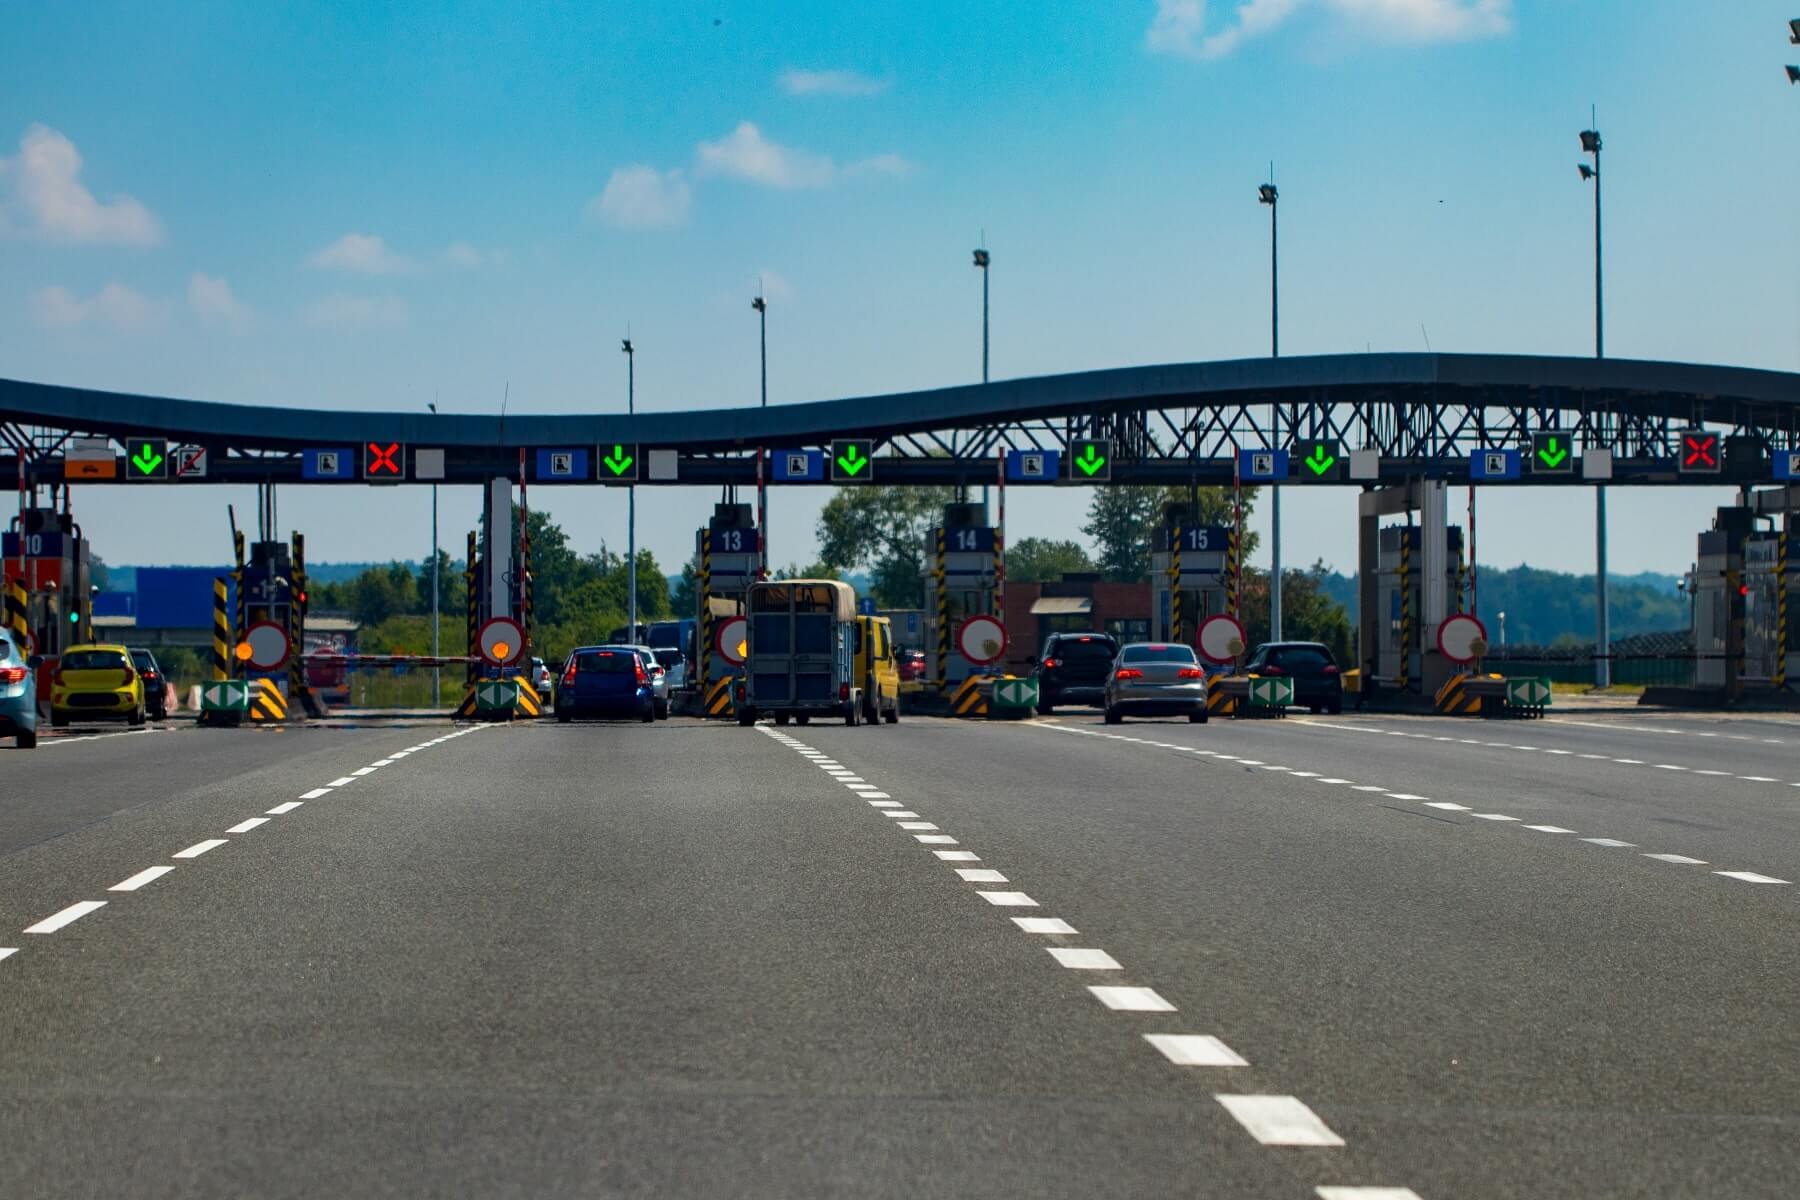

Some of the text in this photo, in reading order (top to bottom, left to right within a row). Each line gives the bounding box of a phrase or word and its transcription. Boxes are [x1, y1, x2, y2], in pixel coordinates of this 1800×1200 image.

[26, 534, 42, 555] 10
[722, 530, 742, 551] 13
[957, 529, 977, 550] 14
[1189, 529, 1208, 550] 15
